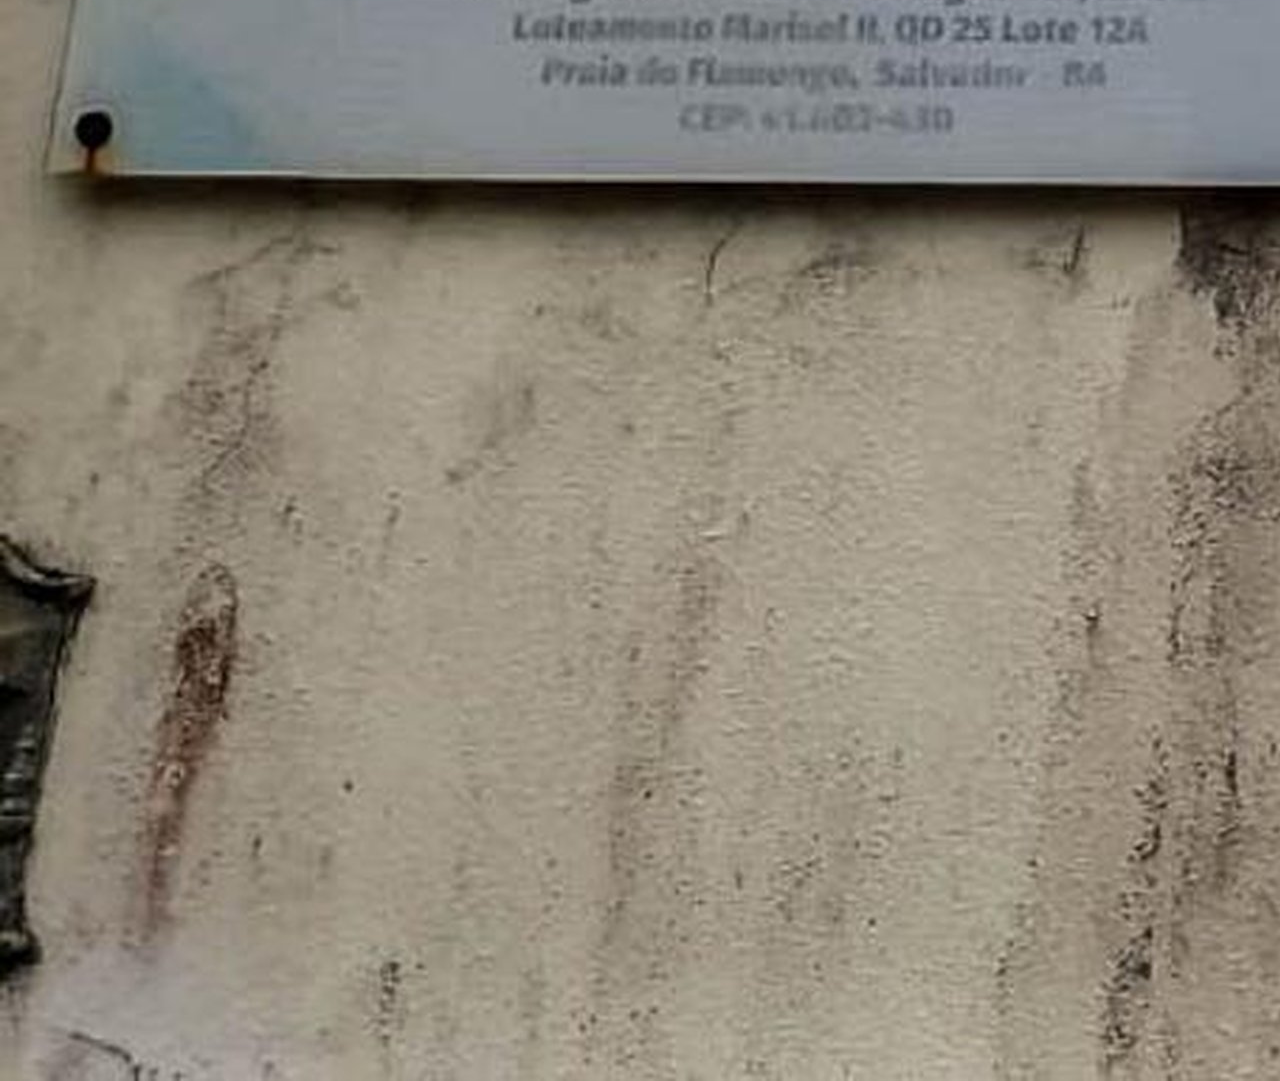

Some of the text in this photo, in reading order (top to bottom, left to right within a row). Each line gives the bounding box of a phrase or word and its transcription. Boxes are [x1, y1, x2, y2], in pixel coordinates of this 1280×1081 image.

[953, 18, 993, 43] 25
[1003, 17, 1079, 43] Lote
[541, 56, 629, 87] Praia
